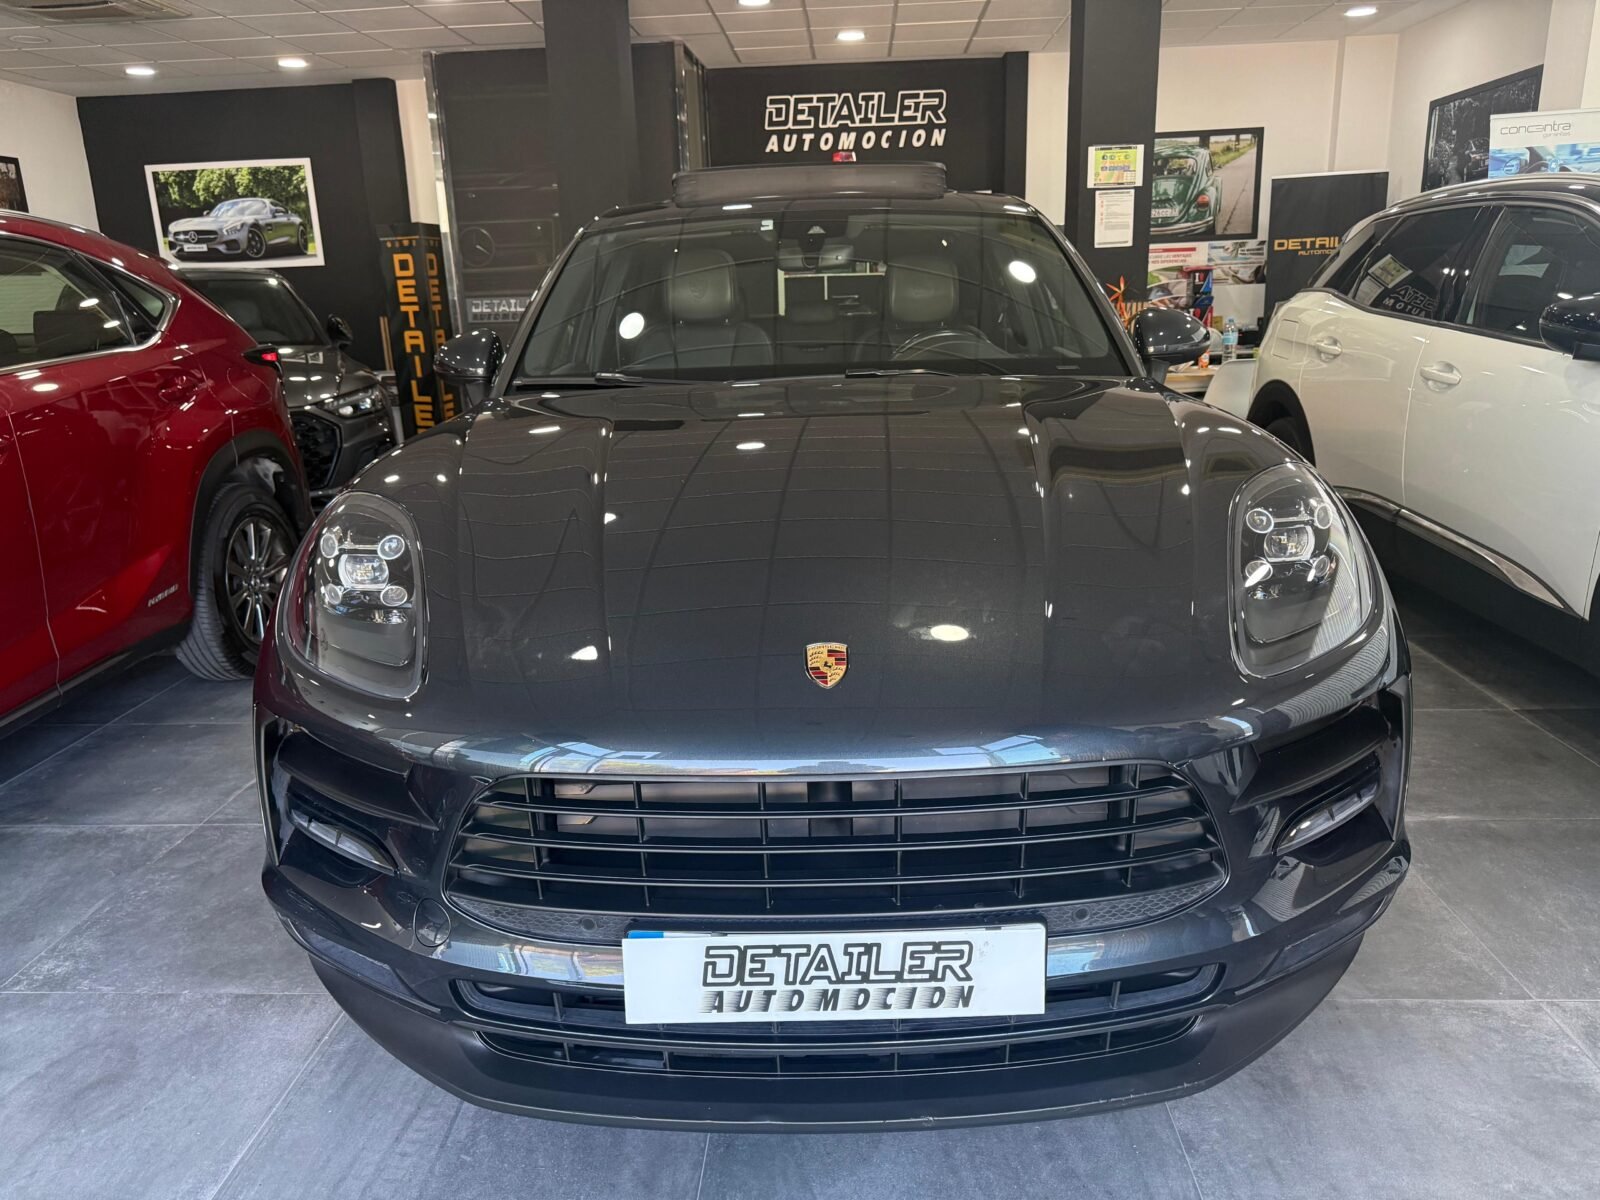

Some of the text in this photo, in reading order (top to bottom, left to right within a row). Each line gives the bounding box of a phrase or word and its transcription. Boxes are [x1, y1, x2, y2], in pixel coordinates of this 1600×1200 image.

[764, 89, 947, 131] DETAILER
[764, 128, 947, 153] AUTOMOCION
[1500, 120, 1572, 136] concentra
[1273, 236, 1341, 252] DETAIL
[1297, 248, 1334, 257] AUTOMO
[471, 299, 529, 313] DETAIL
[393, 253, 436, 434] DETAILE
[703, 941, 974, 987] DETAILER
[700, 985, 975, 1014] AUTOMOCION
